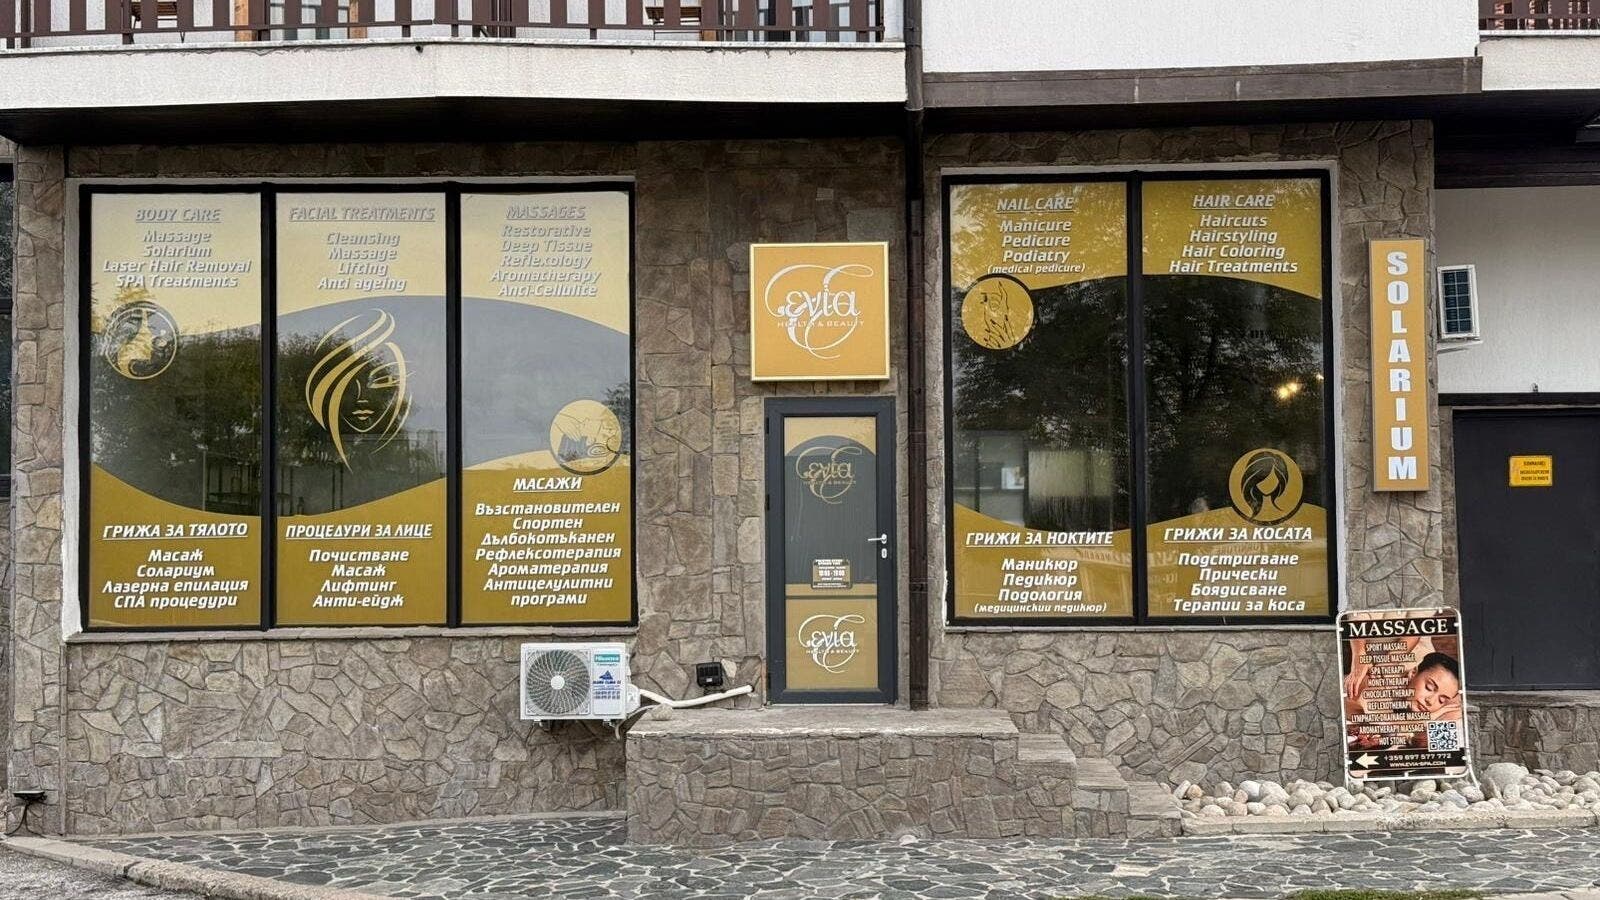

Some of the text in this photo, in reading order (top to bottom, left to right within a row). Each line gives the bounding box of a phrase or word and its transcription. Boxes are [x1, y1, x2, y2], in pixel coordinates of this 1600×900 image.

[997, 198, 1074, 211] NAIL CARE
[1193, 195, 1275, 207] HAIR CARE
[135, 208, 222, 221] BODY CARE
[289, 207, 435, 220] FACIAL TREATMENTS
[506, 205, 586, 218] MASSAGES
[1000, 220, 1072, 232] Manicure
[1200, 215, 1268, 227] Haircuts
[143, 230, 211, 243] Massage
[502, 224, 591, 237] Restorative
[1190, 230, 1277, 244] Hairstyling
[327, 232, 400, 246] Cleansing
[1002, 235, 1070, 248] Pedicure
[144, 245, 211, 258] Solarium
[501, 240, 592, 254] Deep Tissue
[1182, 245, 1285, 259] Hair Coloring
[329, 248, 397, 261] Massage
[1003, 250, 1070, 263] Podiatry
[103, 260, 251, 272] Laser Hair Removal
[501, 255, 592, 269] Reflexology
[988, 263, 1085, 274] (medical pedicure)
[1169, 261, 1298, 273] Hair Treatments
[338, 263, 388, 276] Lifting
[116, 275, 239, 288] SPA Treatments
[491, 270, 601, 283] Aromatherapy
[318, 277, 407, 291] Anti ageing
[498, 284, 598, 297] Anti-Cellulite
[1387, 251, 1416, 480] SOLARIUM
[513, 477, 582, 490] МАСАЖИ
[476, 502, 620, 516] Възстановителен
[513, 517, 583, 530] Спортен
[103, 523, 248, 538] ГРИЖА ЗА ТЯЛОТО
[285, 524, 432, 538] ПРОЦЕДУРИ ЗА ЛИЦЕ
[1164, 527, 1312, 540] ГРИЖИ ЗА КОСАТА
[481, 532, 615, 546] Дълбокотъканен
[966, 532, 1113, 545] ГРИЖИ ЗА НОКТИТЕ
[148, 549, 203, 562] Масаж
[309, 549, 409, 562] Почистване
[475, 548, 621, 562] Рефлексотерапия
[1178, 553, 1298, 567] Подстригване
[331, 564, 386, 577] Масаж
[488, 563, 608, 577] Ароматерапия
[1001, 558, 1078, 571] Маникюр
[137, 565, 214, 578] Солариум
[1200, 568, 1278, 582] Прически
[103, 580, 248, 594] Лазерна епилация
[321, 580, 396, 594] Лифтинг
[483, 578, 613, 591] Антицелулитни
[1003, 574, 1077, 588] Педикюр
[998, 588, 1082, 603] Подология
[1191, 584, 1287, 597] Боядисване
[115, 595, 237, 609] СПА процедури
[313, 594, 404, 609] Анти-ейдж
[511, 594, 587, 607] програми
[1174, 599, 1305, 613] Терапии за коса
[1054, 603, 1106, 613] педикюр)
[1349, 619, 1448, 637] MASSAGE
[1383, 642, 1407, 650] MASSAGE
[1391, 654, 1415, 662] MASSAGE
[1382, 666, 1404, 674] THERAPY
[1393, 689, 1414, 697] THERAPY
[1368, 702, 1412, 710] REFLEXOTHERAPY
[1407, 712, 1431, 720] MASSAGE
[1360, 724, 1424, 733] AROMATHERAPY MASSAGE
[1390, 737, 1407, 745] STONE
